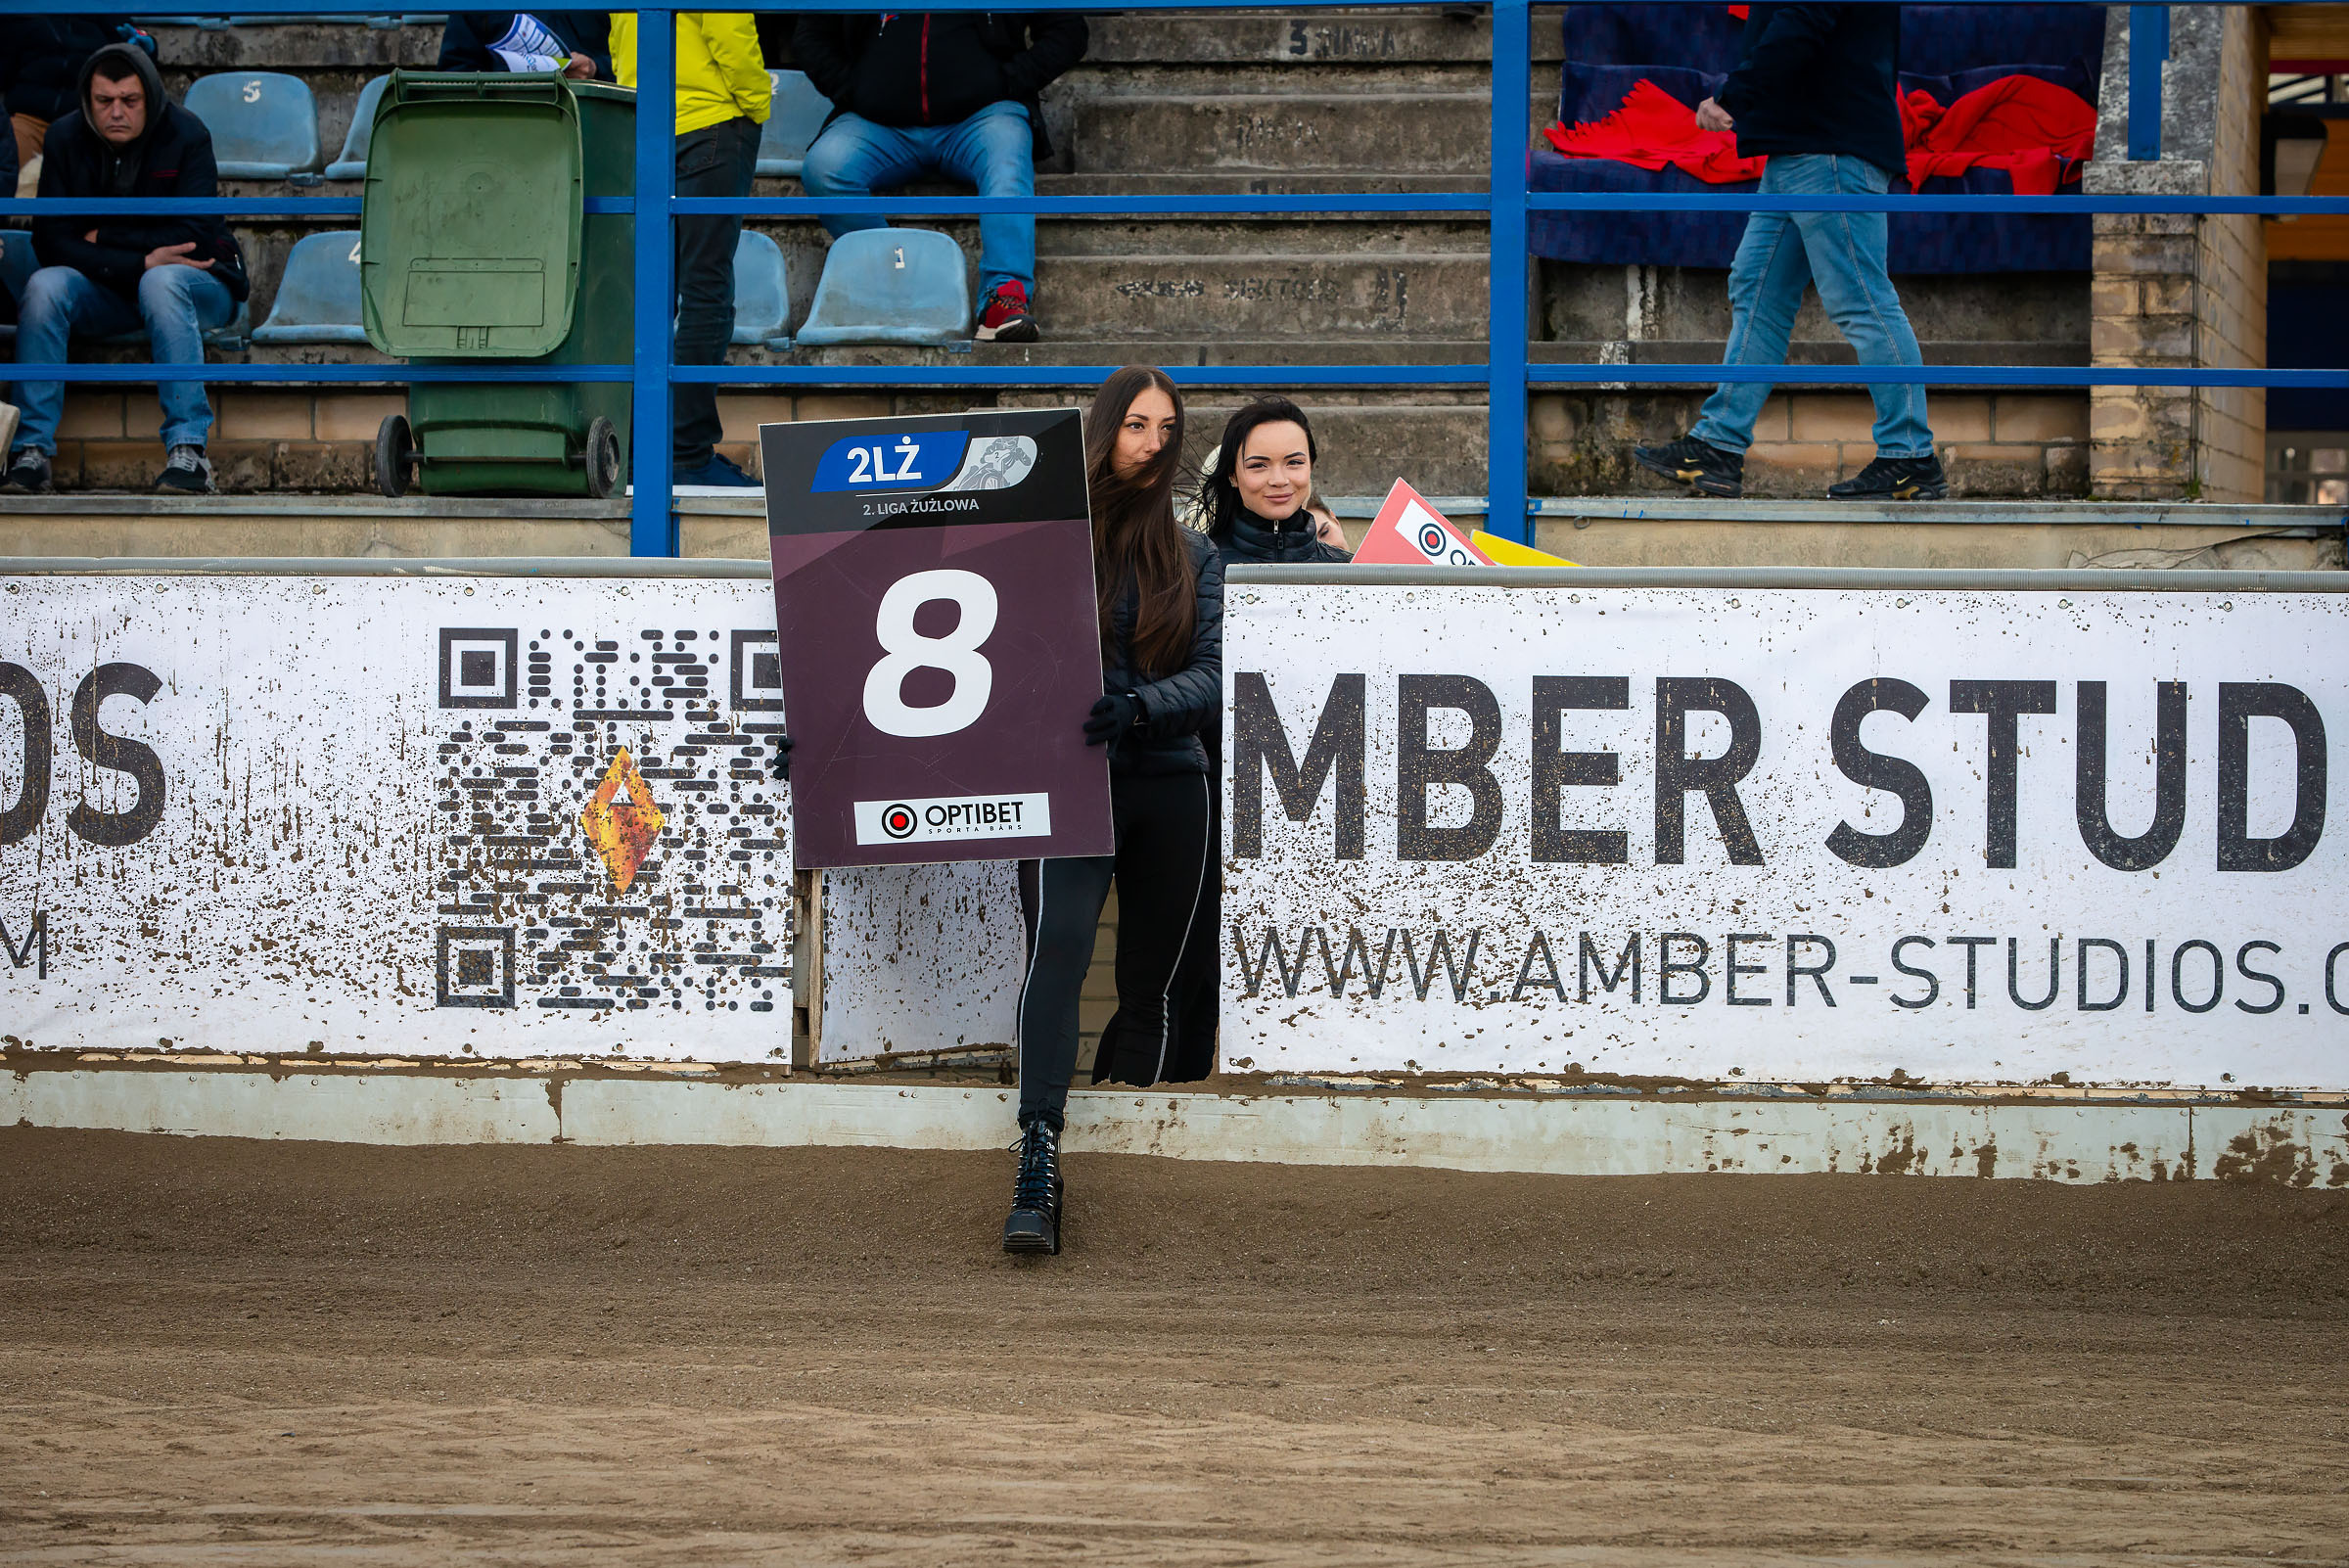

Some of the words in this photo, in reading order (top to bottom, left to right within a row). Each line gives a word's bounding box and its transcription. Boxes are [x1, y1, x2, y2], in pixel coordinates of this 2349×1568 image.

[243, 80, 261, 103] 5
[348, 241, 361, 264] 4
[895, 248, 905, 269] 1
[847, 436, 922, 484] 2LŻ
[862, 504, 875, 516] 2.
[877, 502, 908, 516] LIGA
[910, 498, 980, 514] ŻUŻLOWA
[862, 569, 998, 738] 8
[1232, 671, 1766, 866] MBER
[1824, 676, 2328, 873] STUD
[925, 801, 1024, 826] OPTIBET
[928, 826, 980, 835] SPORTA
